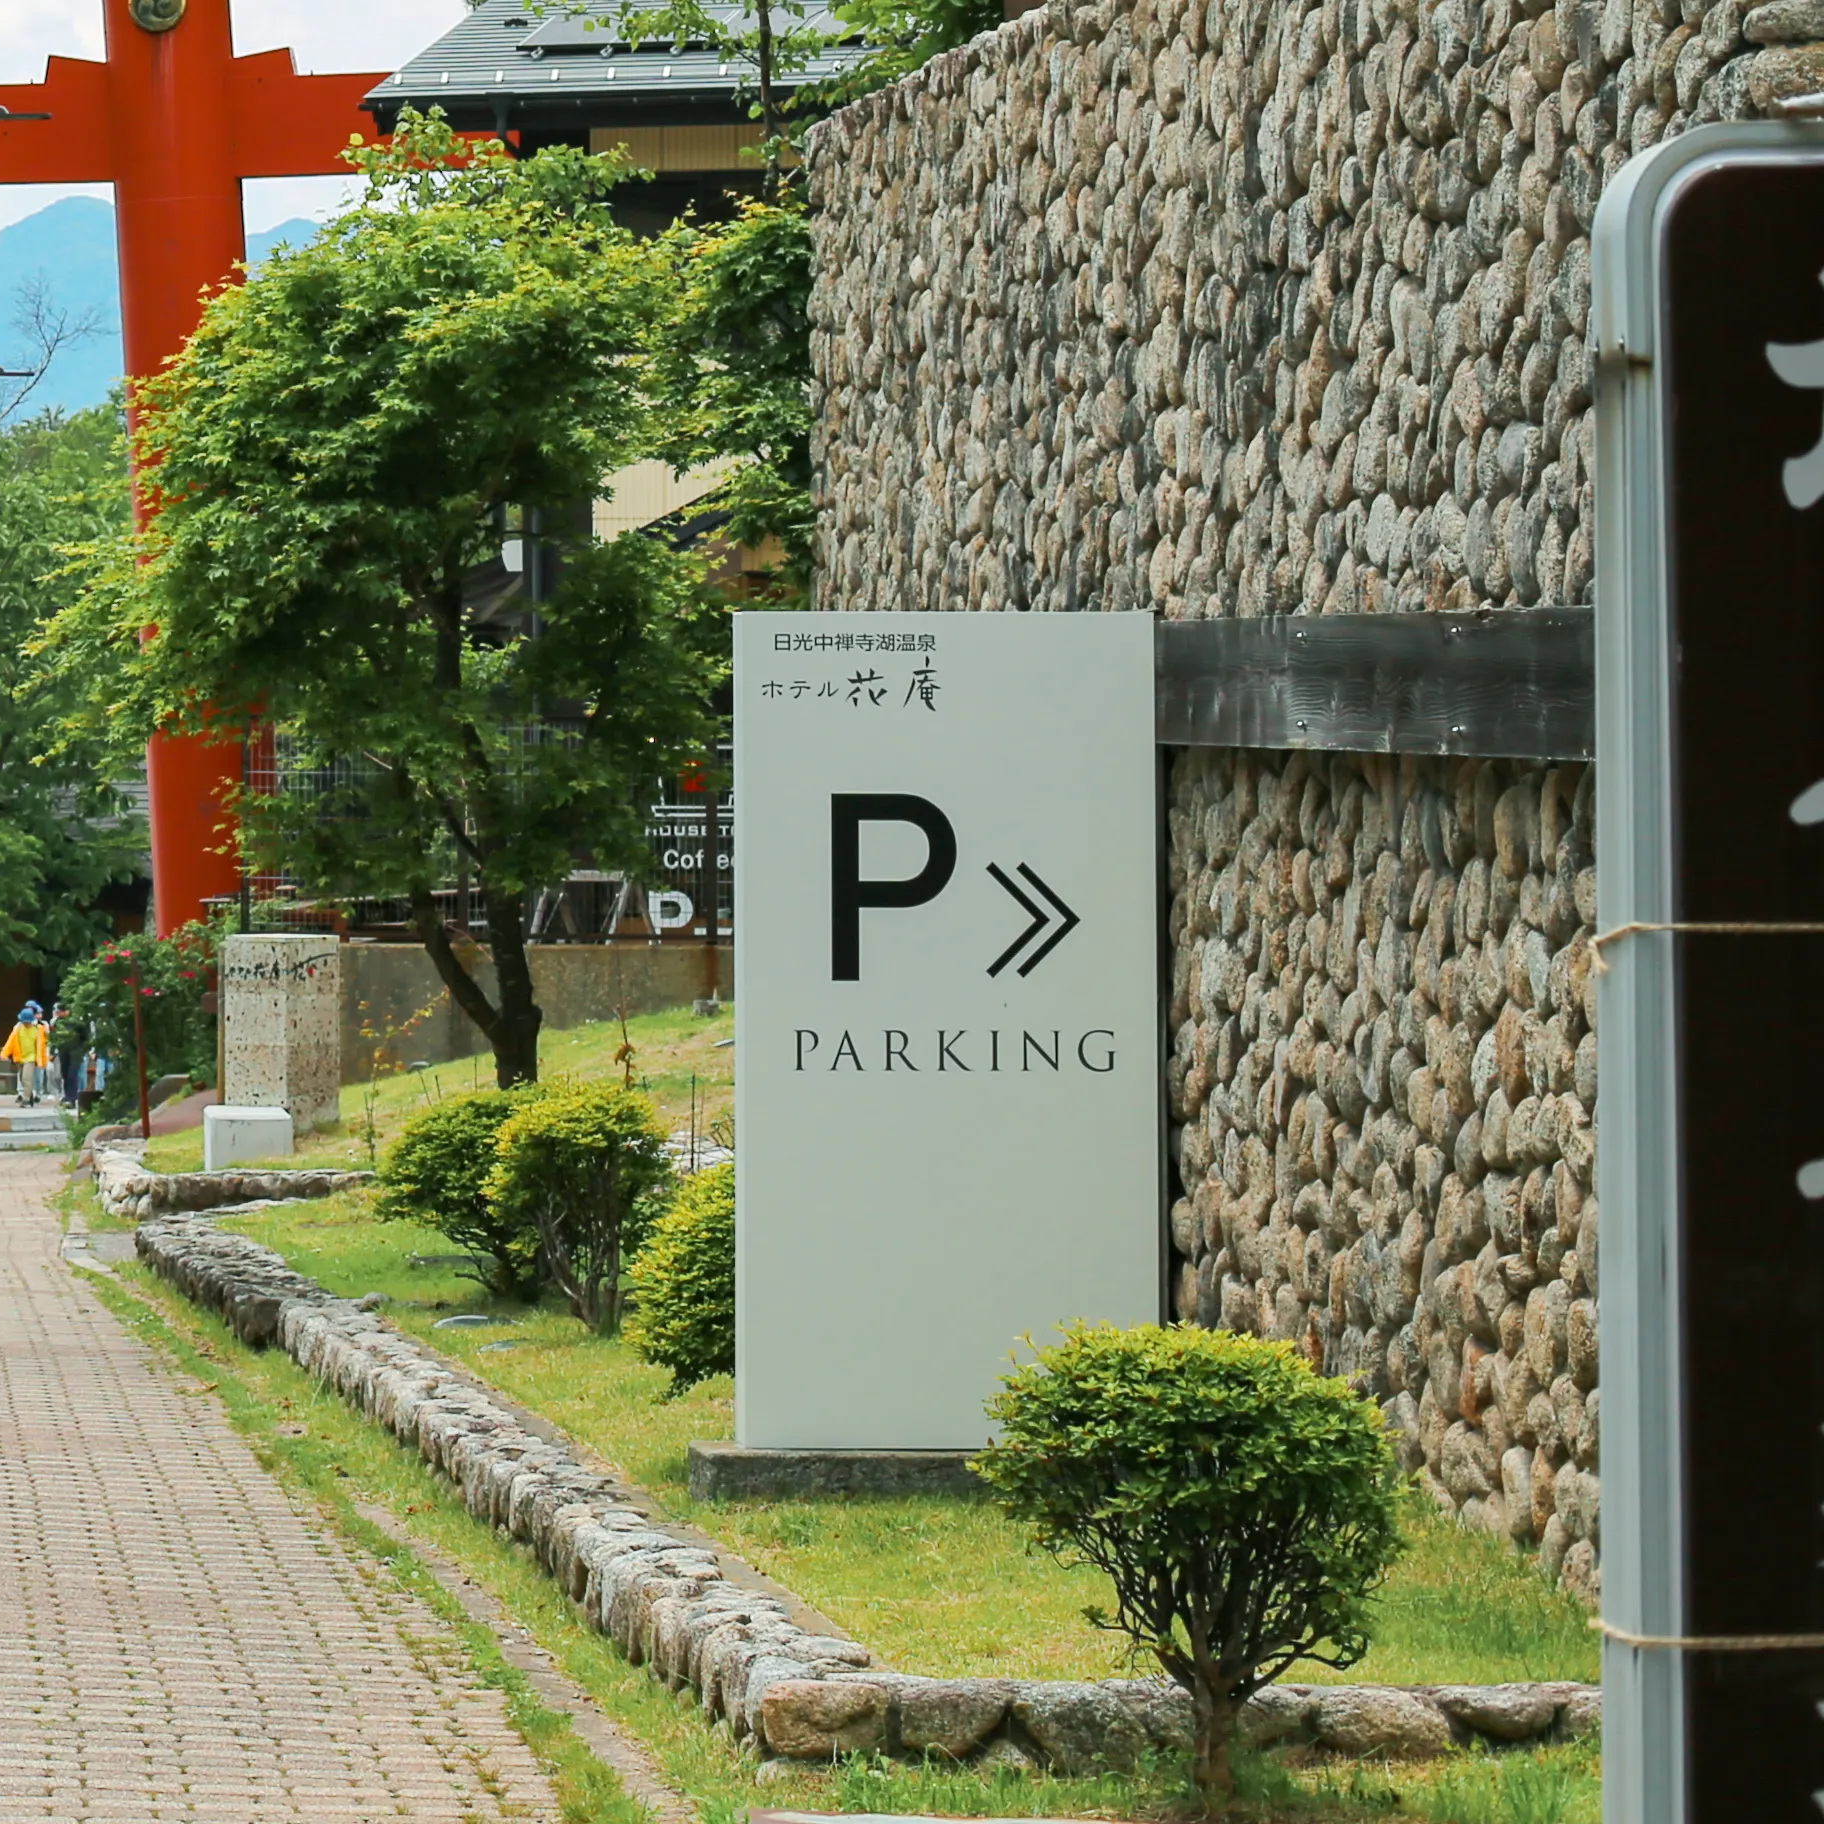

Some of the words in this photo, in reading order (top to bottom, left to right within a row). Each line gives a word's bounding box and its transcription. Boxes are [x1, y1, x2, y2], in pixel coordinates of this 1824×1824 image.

[773, 633, 937, 652] 日光中禅寺湖温泉
[663, 849, 734, 870] Cofe
[831, 792, 958, 982] P
[792, 1028, 1119, 1074] PARKING
